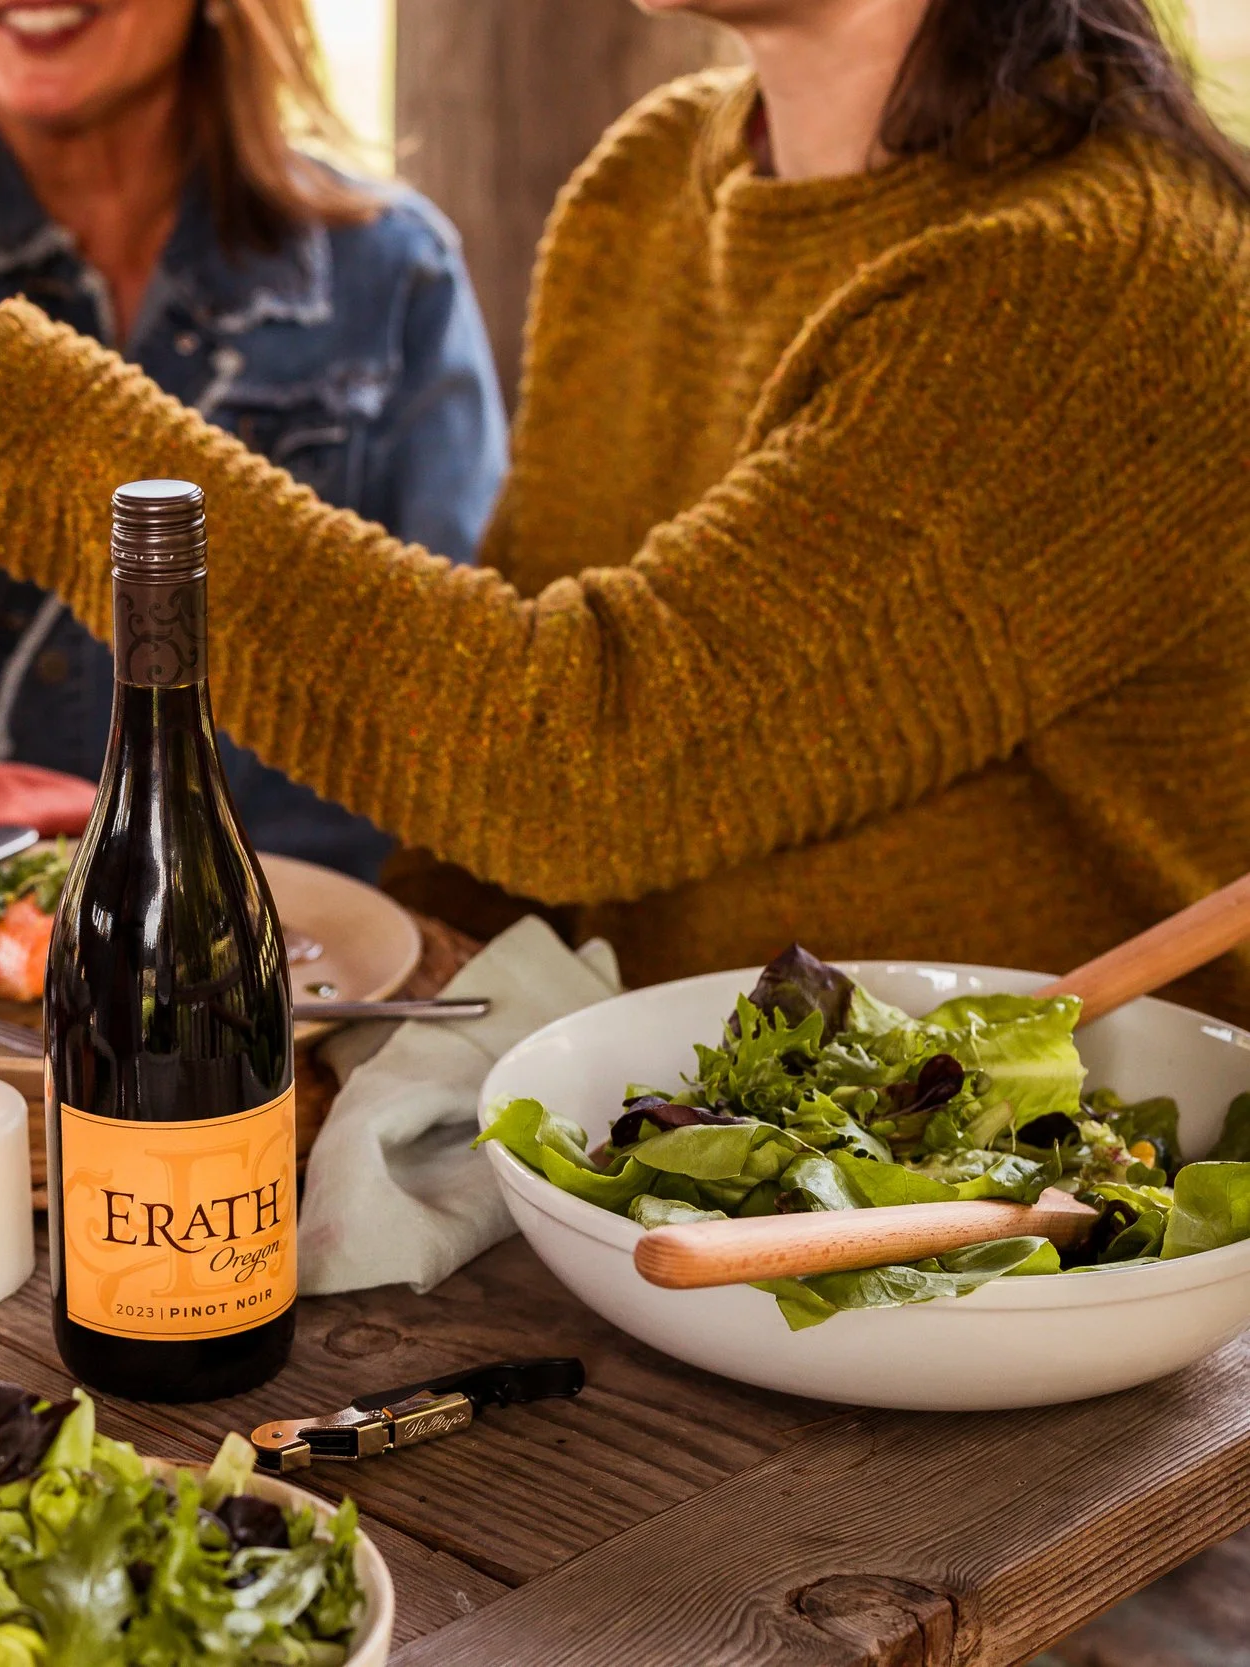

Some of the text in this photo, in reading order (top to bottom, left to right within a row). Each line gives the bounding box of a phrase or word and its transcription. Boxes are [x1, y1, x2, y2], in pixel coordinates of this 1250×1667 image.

[101, 1178, 280, 1253] ERATH
[209, 1240, 279, 1282] Oregon
[116, 1288, 272, 1318] 2023 PINOT NOIR
